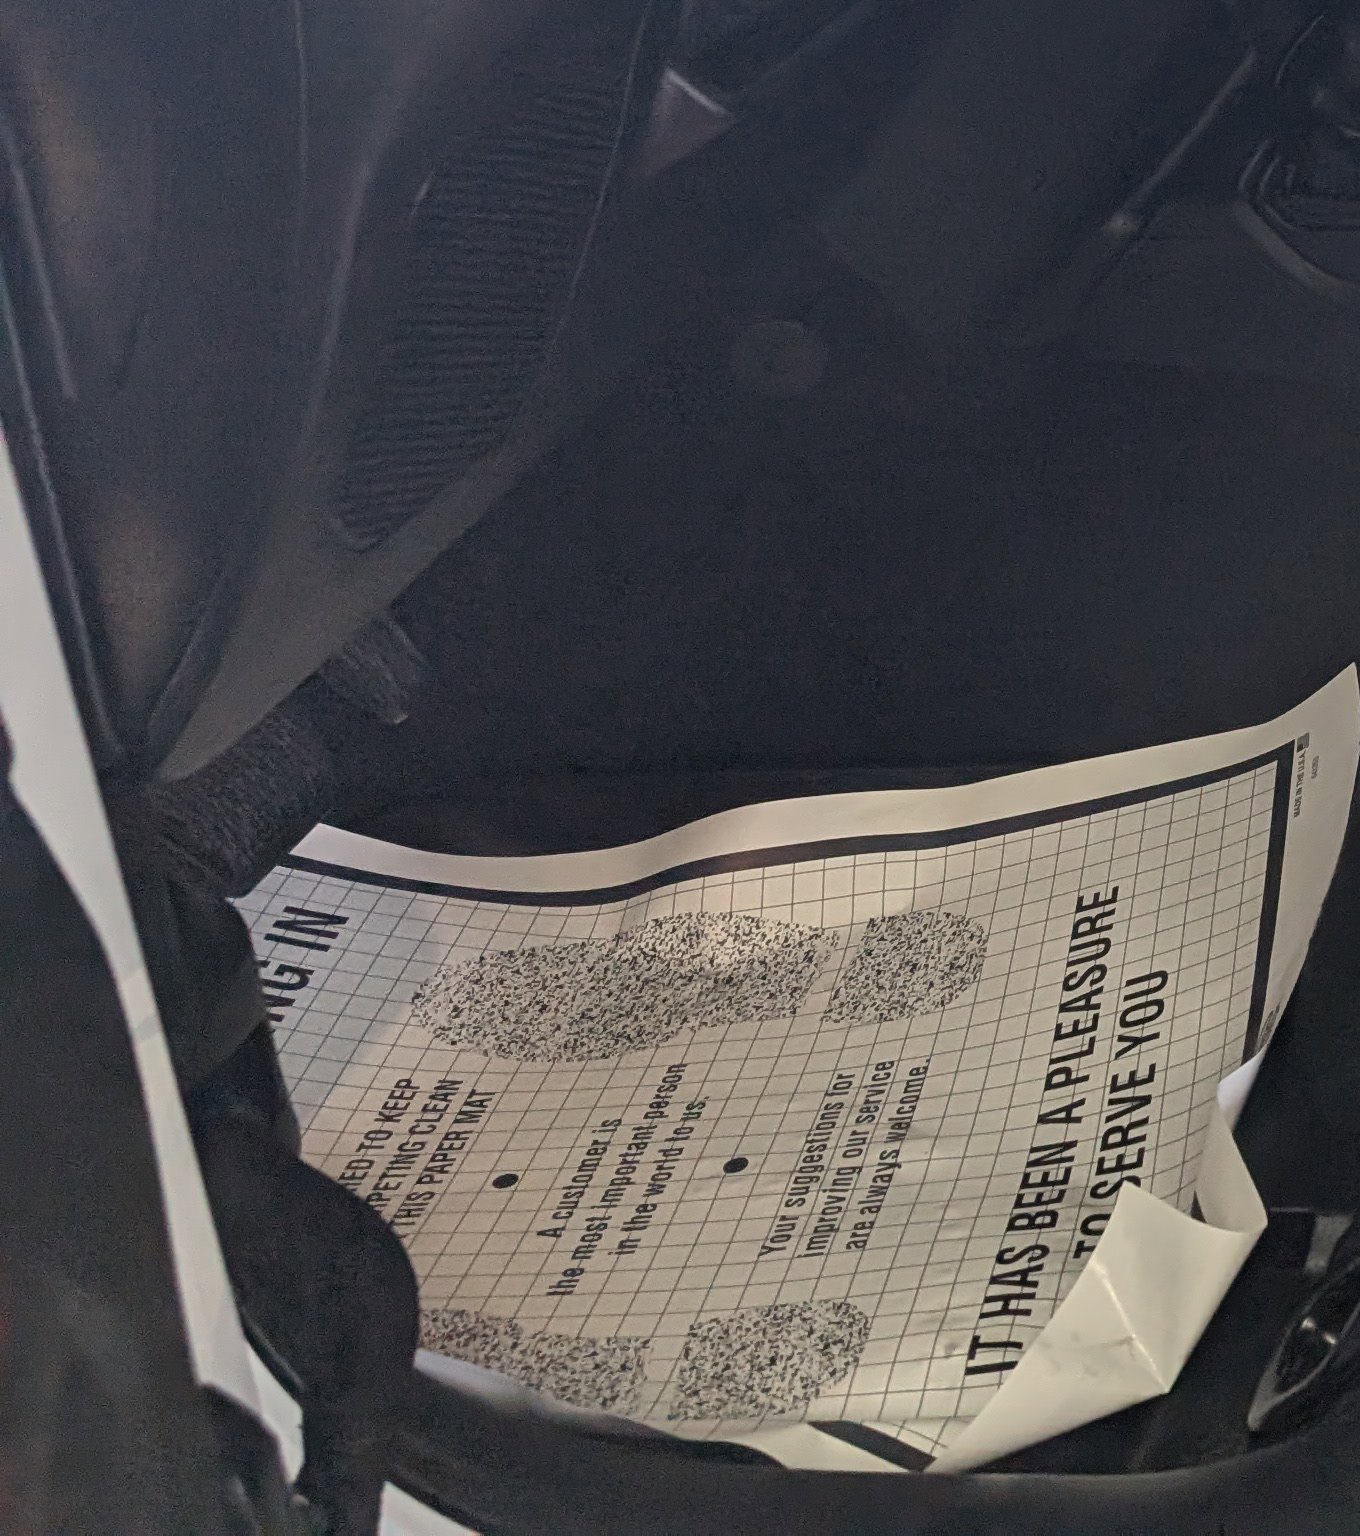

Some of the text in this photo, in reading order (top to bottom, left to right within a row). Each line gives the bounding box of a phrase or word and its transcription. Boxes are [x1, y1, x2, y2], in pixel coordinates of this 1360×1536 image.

[264, 906, 349, 952] IN
[1114, 970, 1168, 1060] YOU
[355, 1129, 393, 1153] TO
[374, 1078, 420, 1123] KEEP
[366, 1079, 463, 1208] PETING CLEAN
[416, 1130, 474, 1185] PAPER
[453, 1089, 496, 1124] MAT
[537, 1118, 622, 1239] A customer is
[547, 1063, 688, 1296] the most important person
[608, 1096, 709, 1256] in the world to us.
[758, 1073, 855, 1257] Your suggestions for
[797, 1060, 895, 1259] improving our service
[845, 1058, 930, 1250] are always welcome.
[965, 886, 1119, 1376] IT HAS BEEN A PLEASURE
[1090, 1063, 1156, 1200] SERVE
